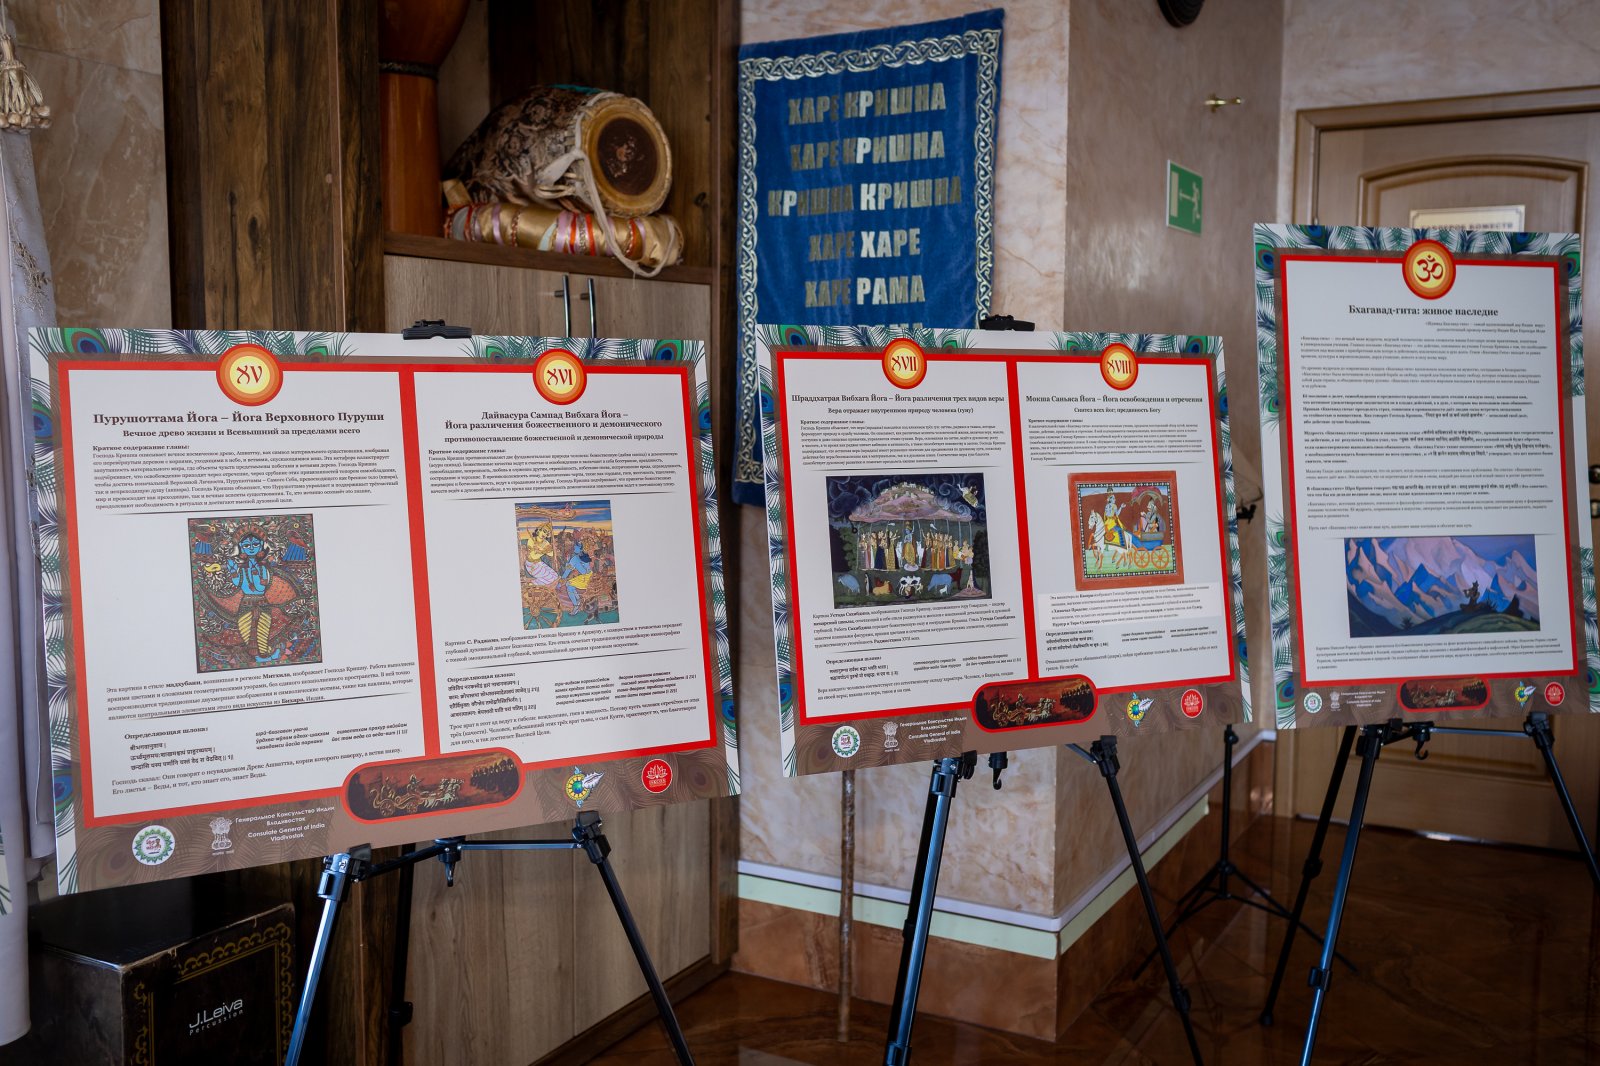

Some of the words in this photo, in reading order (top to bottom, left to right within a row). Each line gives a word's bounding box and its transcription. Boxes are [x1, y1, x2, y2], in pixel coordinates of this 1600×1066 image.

[789, 97, 840, 125] ХАРЕ
[844, 82, 946, 118] КРИШНА
[791, 140, 839, 171] ХАРЕ
[843, 131, 945, 164] КРИШНА
[768, 184, 854, 216] КРИШНА
[860, 176, 962, 210] КРИШНА
[809, 231, 855, 262] ХАРЕ
[860, 228, 920, 258] ХАРЕ
[805, 278, 851, 308] ХАРЕ
[857, 275, 925, 305] РАМА
[1349, 305, 1420, 315] Бхагавад-гита:
[892, 356, 917, 374] XVII
[1107, 359, 1132, 375] XVIII
[235, 364, 262, 385] XV
[547, 368, 573, 386] XVI
[792, 395, 840, 403] Шраддхатрая
[94, 414, 184, 425] Пурушоттама
[187, 412, 218, 422] Йога
[232, 411, 262, 422] Йога
[265, 413, 335, 424] Верховного
[338, 412, 384, 423] Пуруши
[482, 411, 528, 420] Дайвасура
[445, 420, 468, 429] Йога
[124, 730, 181, 740] Определяющая
[236, 814, 275, 823] Генеральное
[276, 809, 315, 818] Консульство
[267, 817, 305, 826] Владивосток
[248, 829, 278, 838] Consulate
[279, 826, 302, 834] General
[271, 833, 304, 842] Vladivostok
[189, 999, 243, 1029] J.Leiva
